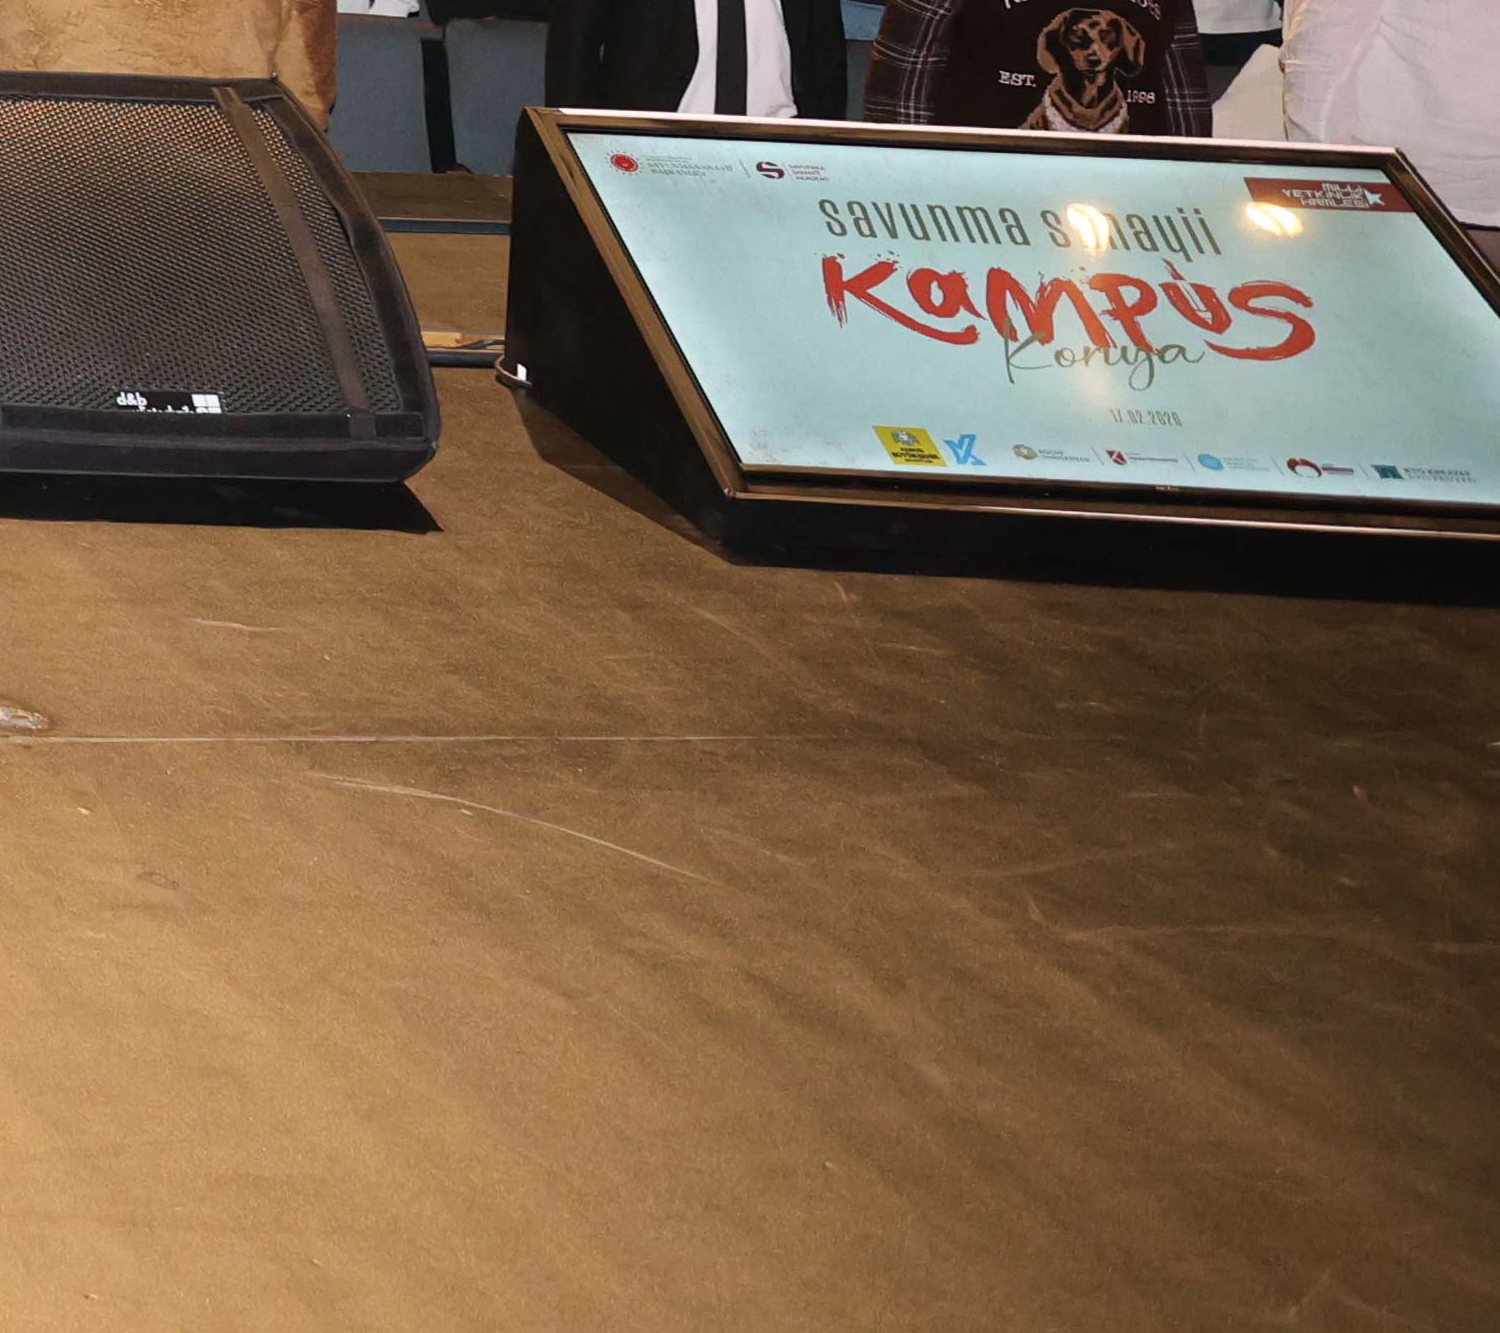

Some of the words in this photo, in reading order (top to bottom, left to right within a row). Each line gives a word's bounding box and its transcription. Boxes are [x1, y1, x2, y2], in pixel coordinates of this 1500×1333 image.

[998, 69, 1037, 87] EST.
[818, 198, 1031, 246] savunma
[1002, 319, 1205, 390] Konya
